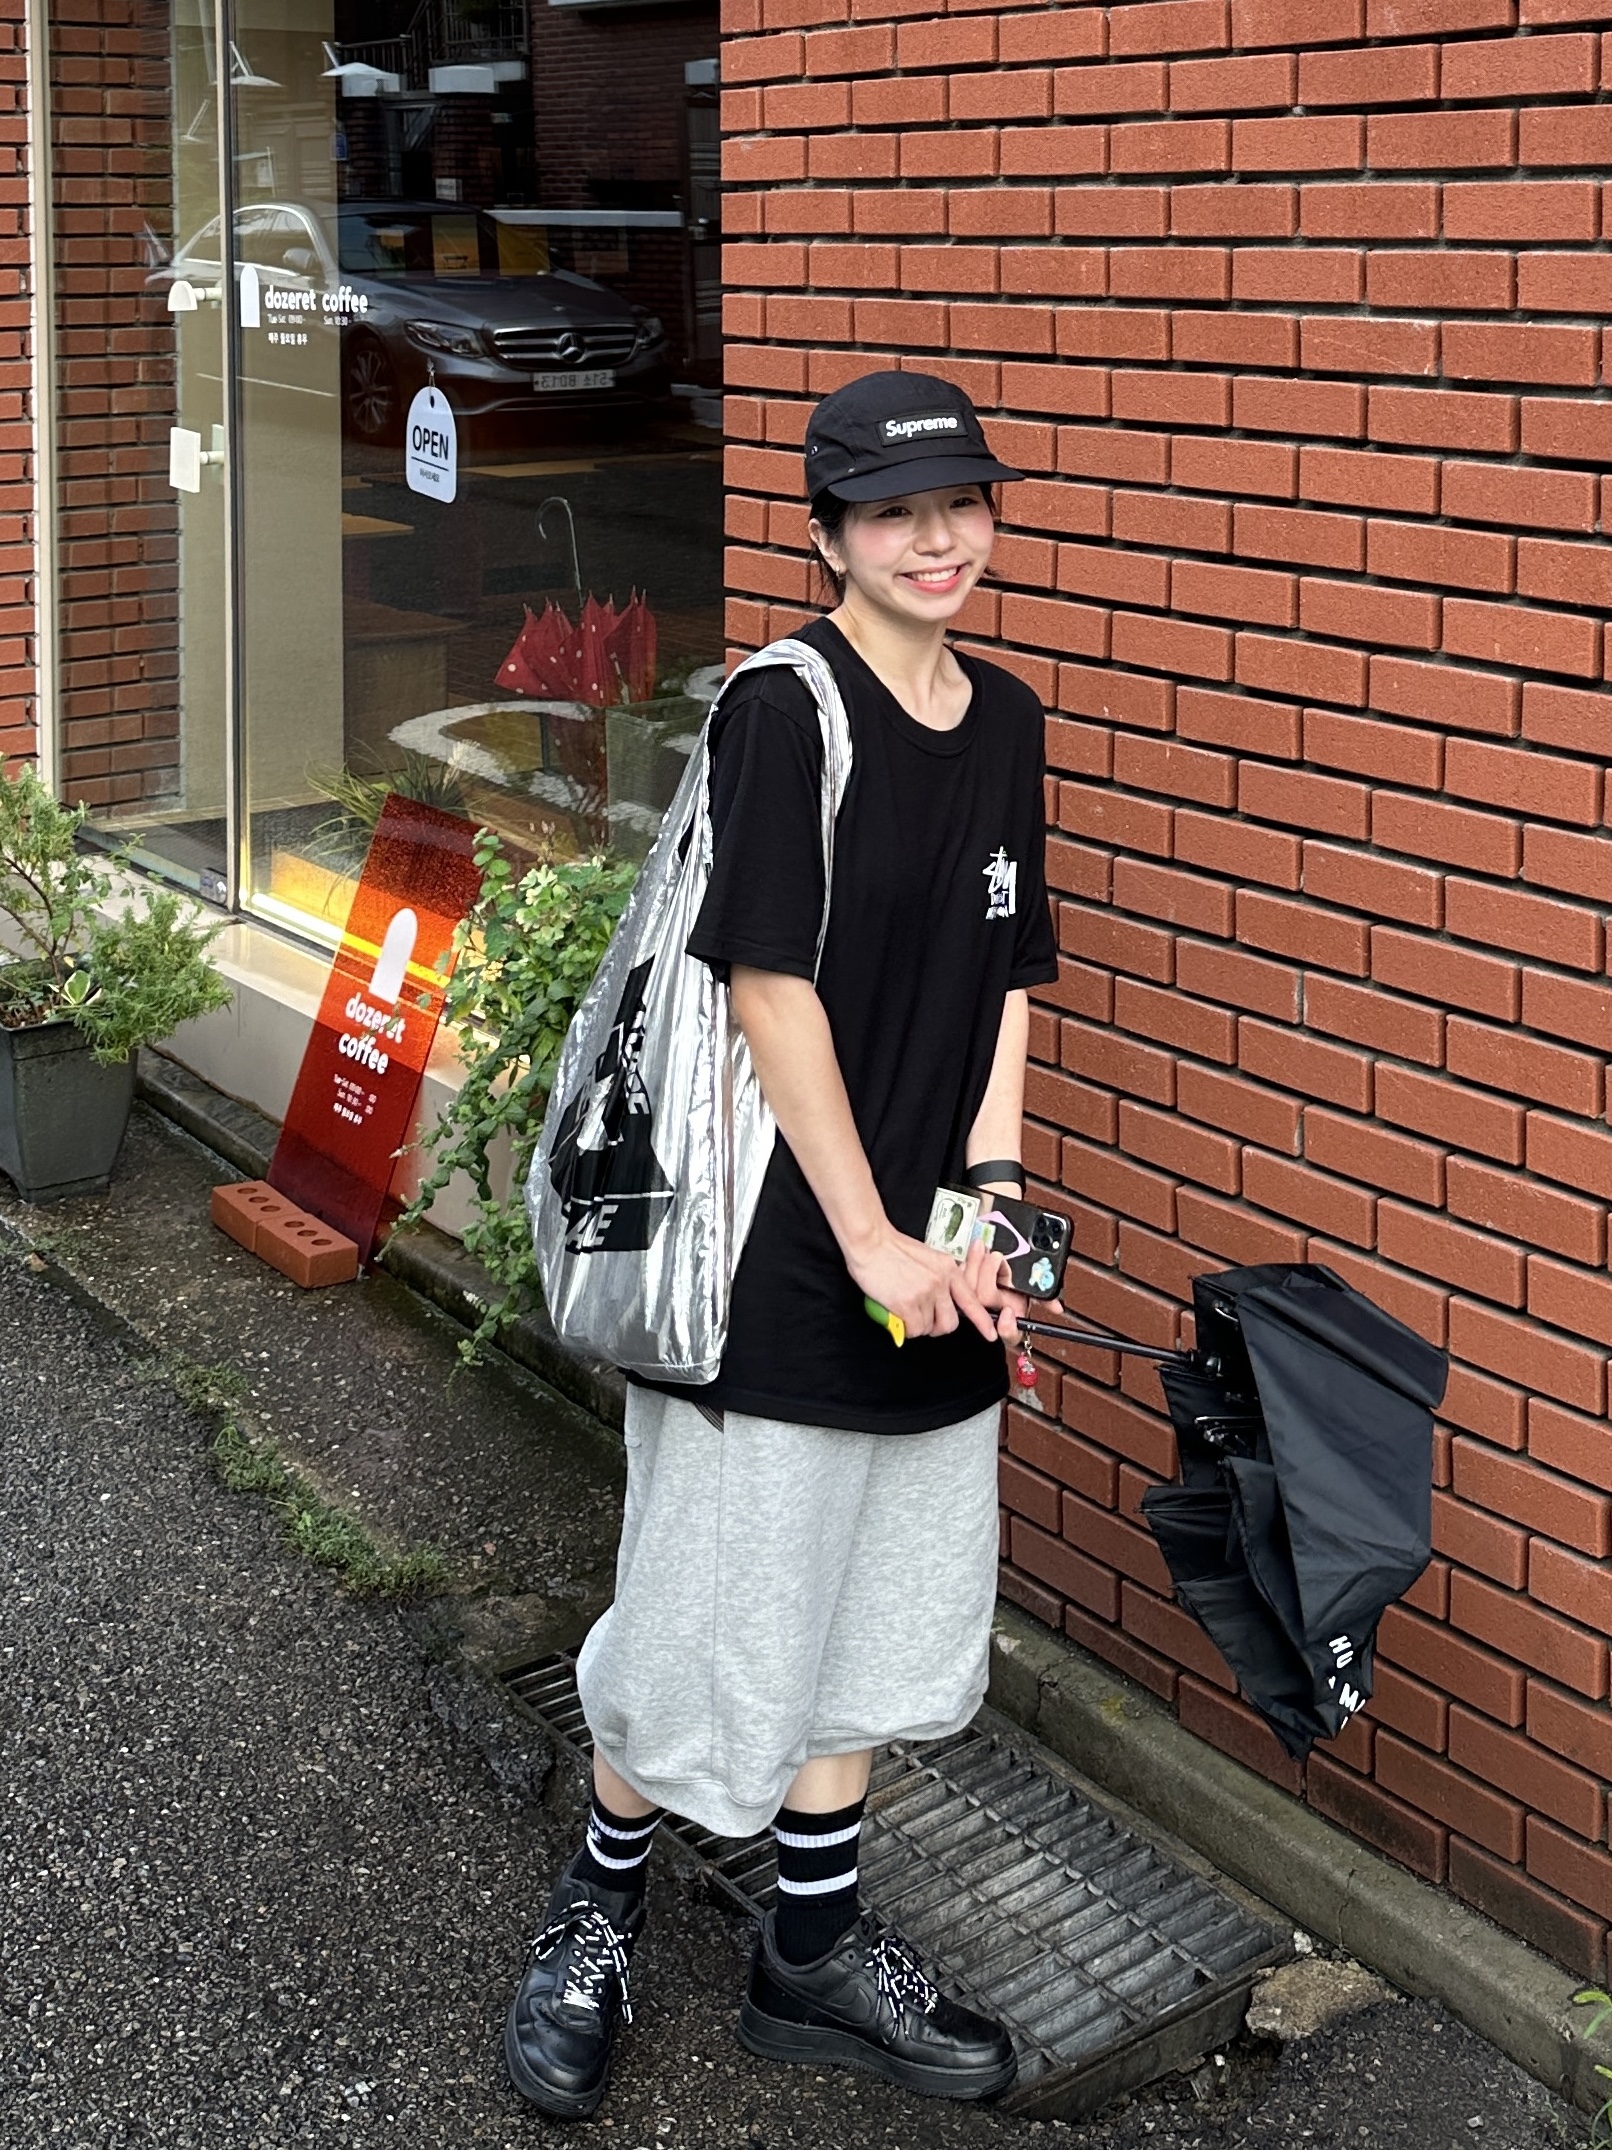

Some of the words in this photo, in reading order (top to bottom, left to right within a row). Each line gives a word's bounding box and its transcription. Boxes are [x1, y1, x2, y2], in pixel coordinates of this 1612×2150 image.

[265, 285, 316, 311] dozeret
[322, 286, 368, 313] coffee
[412, 425, 449, 460] OPEN
[886, 417, 958, 438] Supreme
[339, 1033, 389, 1074] coffee
